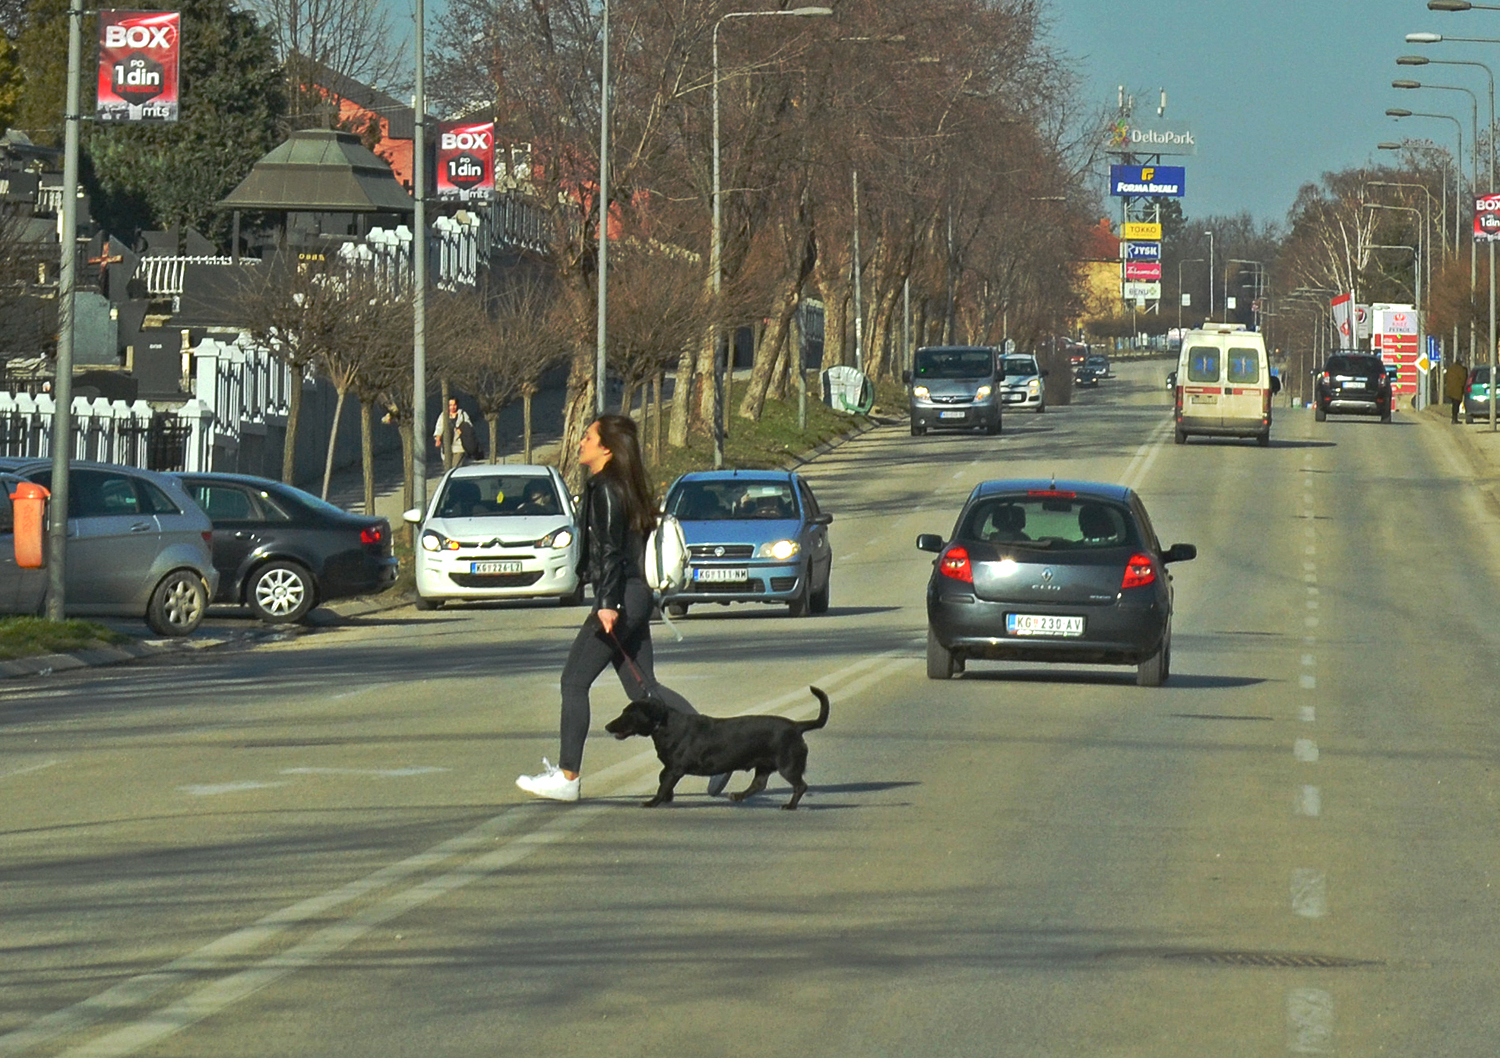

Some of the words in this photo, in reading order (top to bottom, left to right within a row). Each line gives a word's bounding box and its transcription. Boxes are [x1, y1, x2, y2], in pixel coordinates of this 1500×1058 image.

[105, 25, 170, 48] BOX
[115, 65, 124, 85] 1
[127, 68, 159, 85] din
[143, 106, 169, 117] mts
[441, 133, 488, 149] BOX
[1132, 129, 1194, 144] DeltaPark
[449, 161, 456, 176] 1
[458, 163, 481, 176] din
[1117, 182, 1148, 192] FORMA
[1149, 183, 1178, 193] IDEALE
[1486, 218, 1500, 227] din
[1134, 246, 1157, 255] JYSK
[1017, 617, 1031, 628] KG
